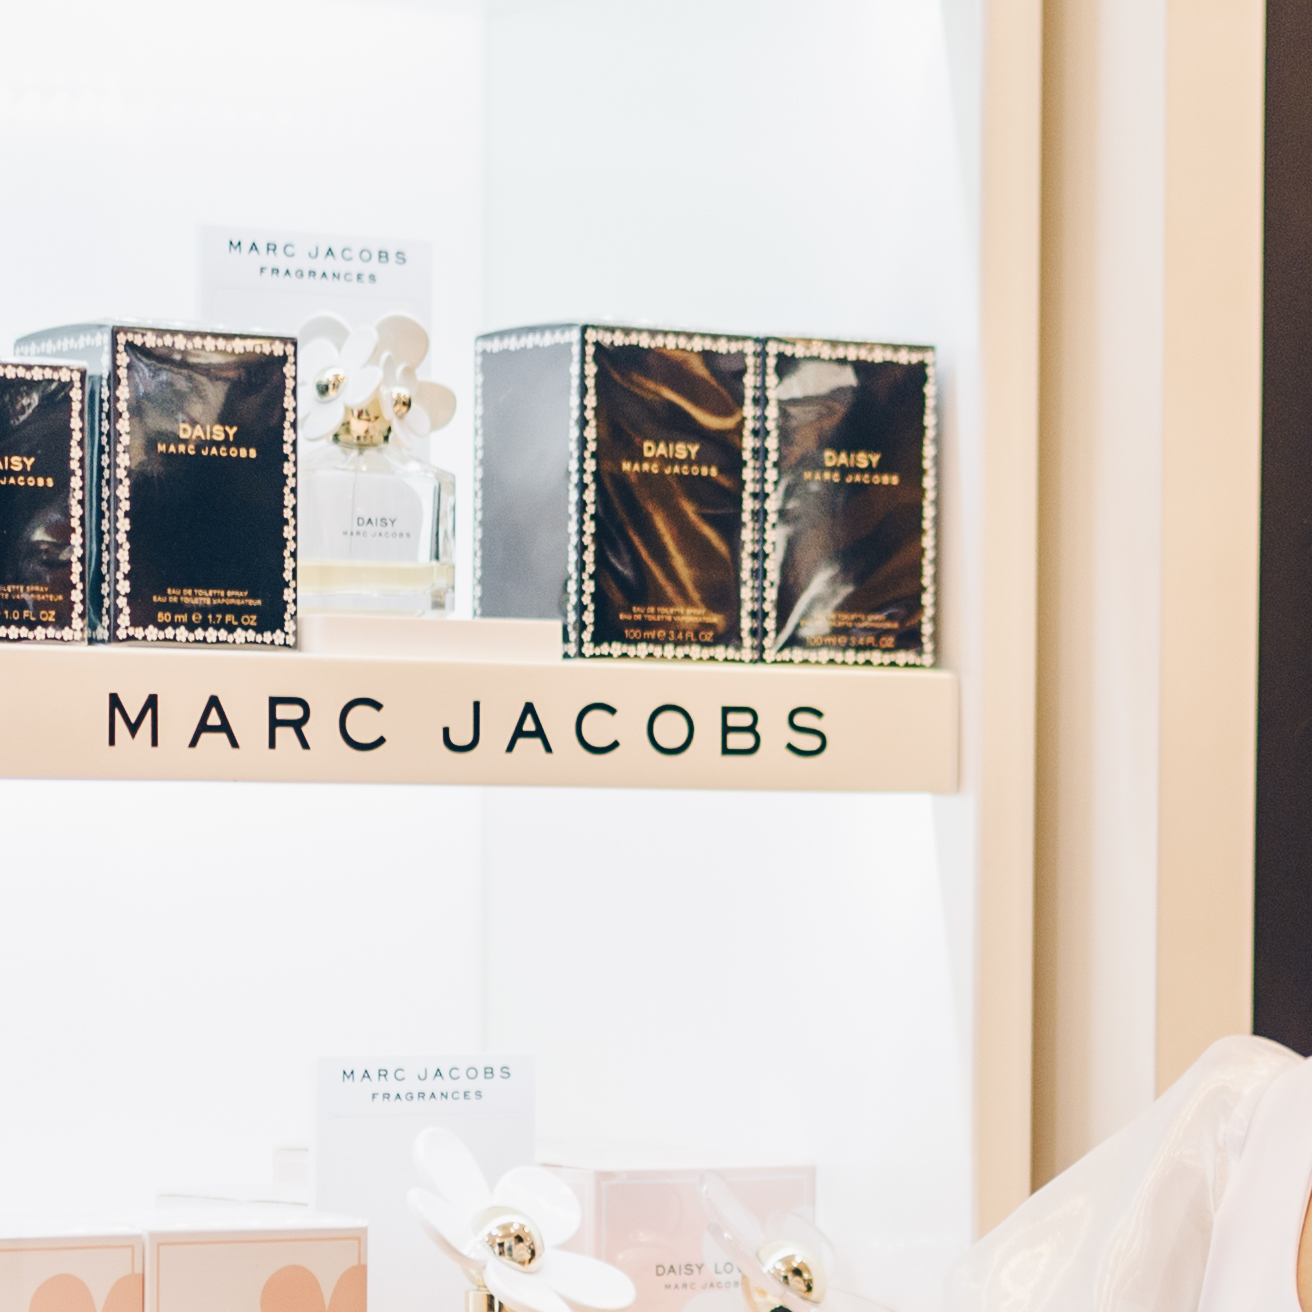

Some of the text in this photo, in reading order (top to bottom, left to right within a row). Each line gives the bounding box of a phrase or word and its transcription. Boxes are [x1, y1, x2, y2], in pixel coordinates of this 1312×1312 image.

[228, 239, 407, 265] MARC JACOBS
[259, 266, 377, 284] FRAGRANCES
[179, 423, 238, 441] DAISY
[157, 442, 257, 459] MARC JACOBS
[642, 440, 700, 461] DAISY
[823, 448, 882, 469] DAISY
[621, 460, 719, 478] MARC JACOBS
[0, 476, 54, 488] JACOBS
[803, 470, 900, 486] MARC JACOBS
[357, 516, 397, 528] DAISY
[4, 610, 20, 620] 1.0
[23, 610, 36, 621] FL
[39, 610, 56, 622] OZ
[157, 611, 257, 626] 50 ml 1.7 FL OZ
[624, 629, 642, 640] 100
[698, 631, 714, 643] OZ
[108, 692, 829, 757] MARC JACOBS
[342, 1066, 512, 1083] MARC JACOBS
[371, 1090, 484, 1103] FRAGRANCES
[655, 1261, 742, 1277] DAISY LO
[664, 1281, 740, 1291] MARC JACOB
